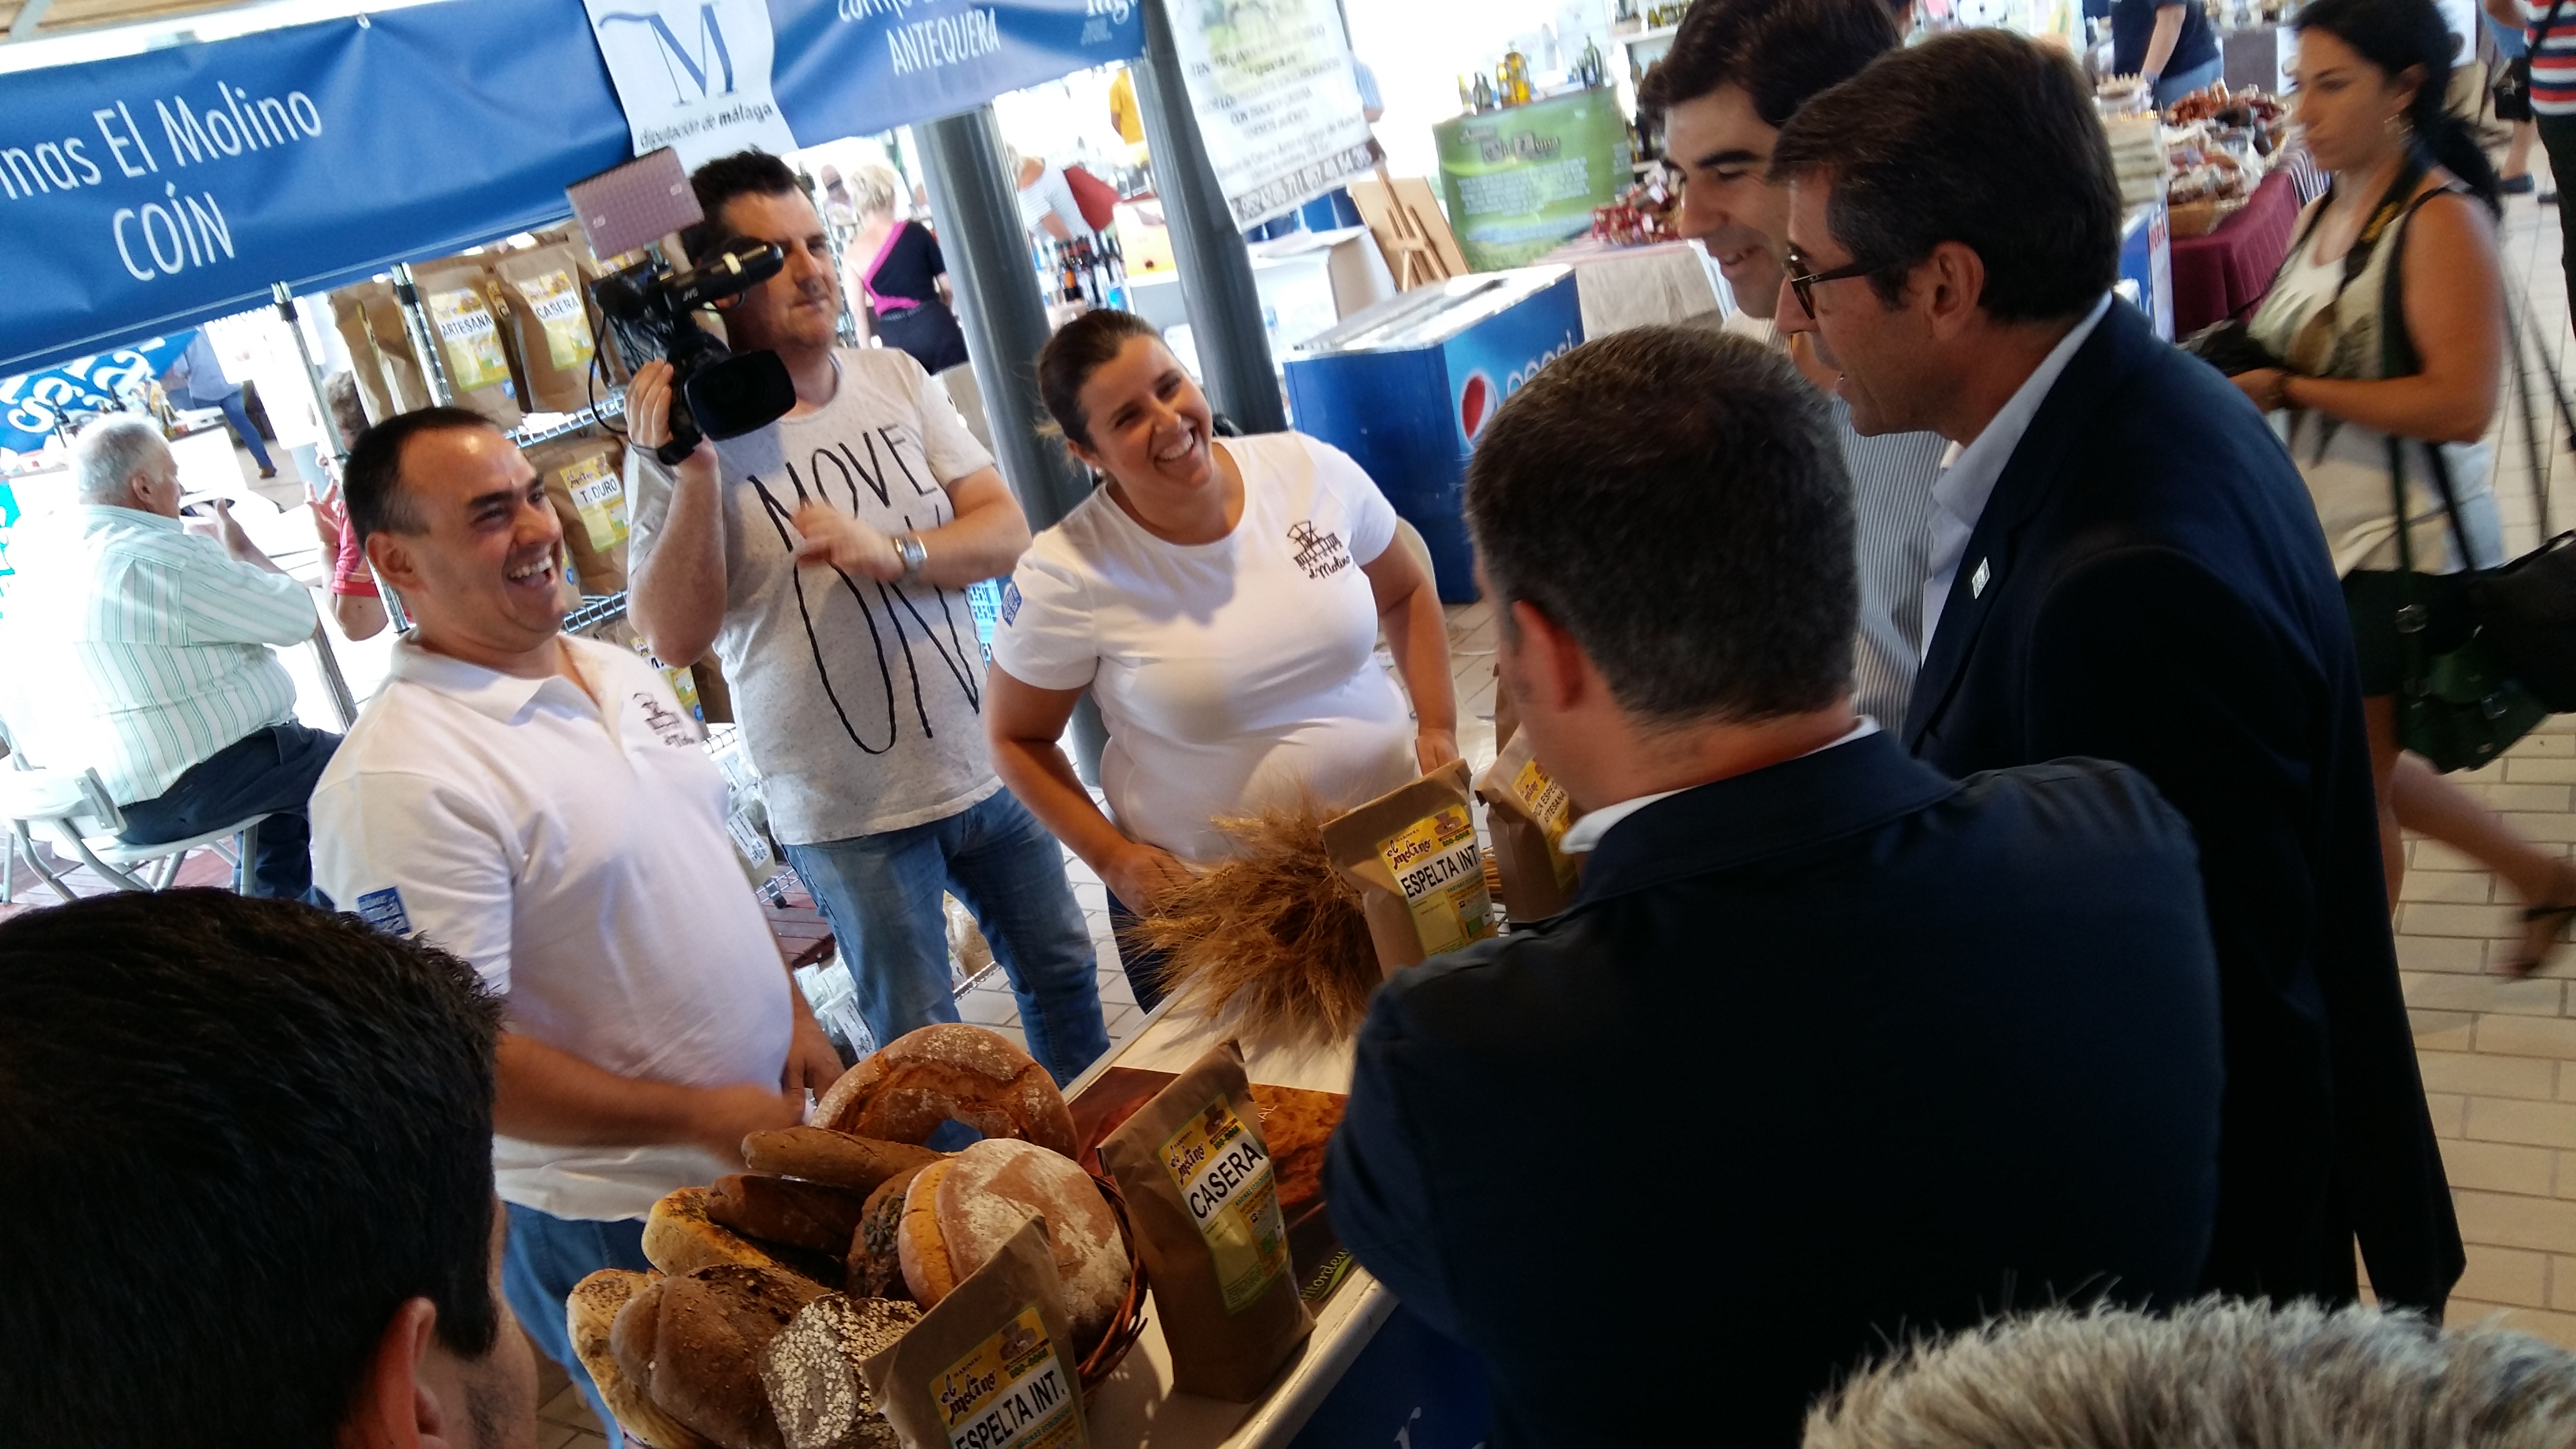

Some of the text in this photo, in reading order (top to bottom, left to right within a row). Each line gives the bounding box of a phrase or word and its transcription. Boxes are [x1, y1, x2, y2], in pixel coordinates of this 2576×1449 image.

[886, 7, 1000, 76] ANTEQUERA
[93, 100, 158, 178] El
[155, 80, 321, 167] Molino
[718, 102, 773, 127] málaga
[112, 180, 235, 281] COÍN
[441, 313, 494, 339] ARTESANA
[537, 295, 581, 320] CASERA
[591, 479, 617, 499] DURO
[747, 425, 937, 552] MOVE
[1387, 839, 1398, 857] el
[1400, 856, 1460, 899] ESPELTA
[1190, 1142, 1264, 1219] CASERA
[940, 1374, 957, 1404] el
[1028, 1369, 1065, 1413] INT.
